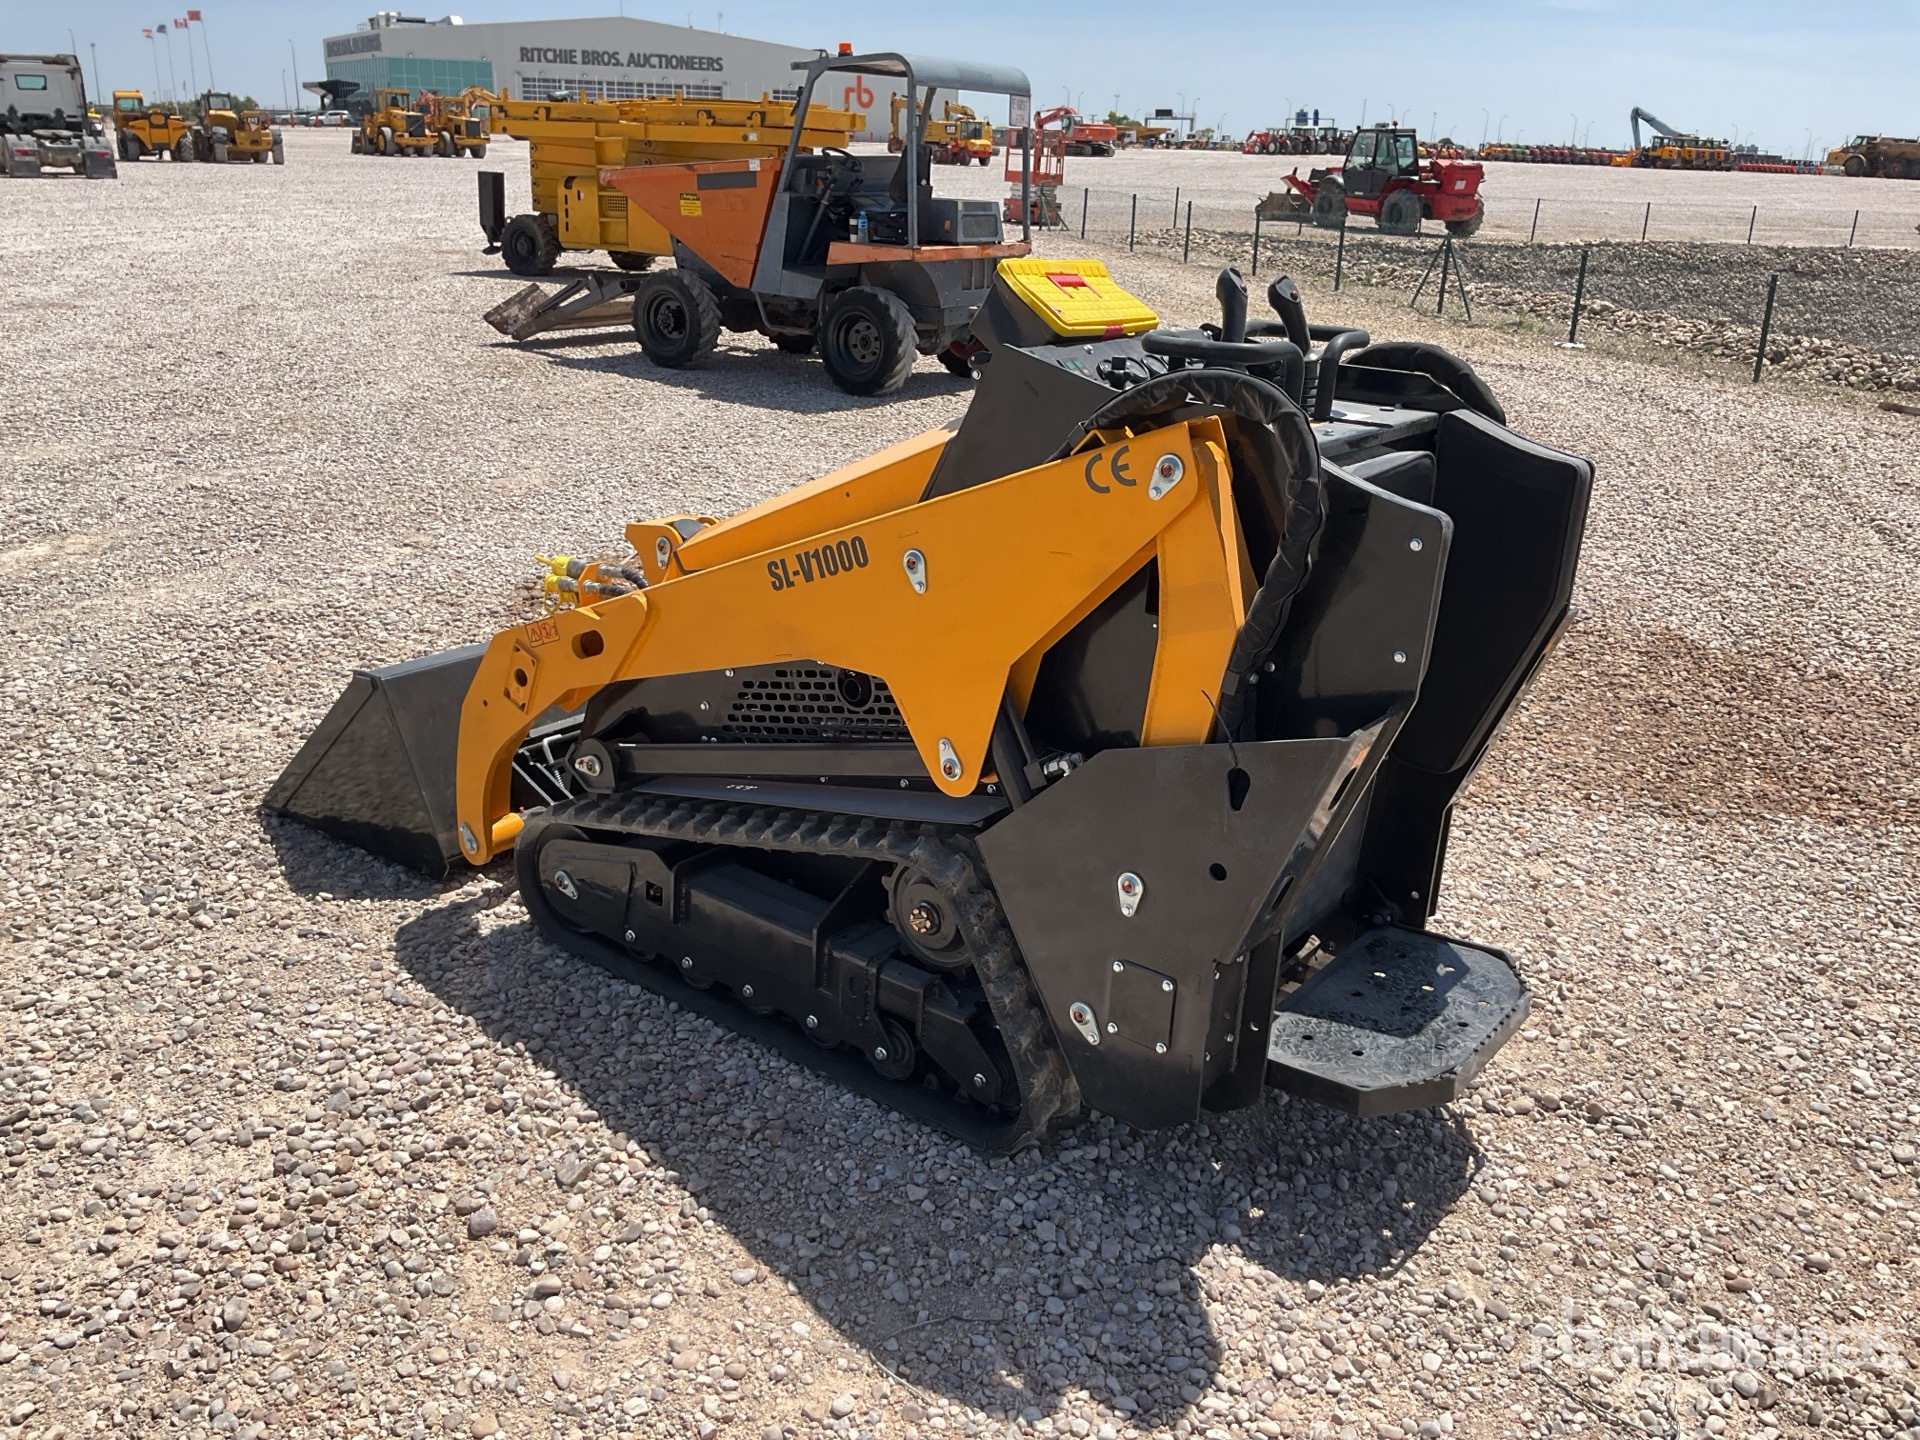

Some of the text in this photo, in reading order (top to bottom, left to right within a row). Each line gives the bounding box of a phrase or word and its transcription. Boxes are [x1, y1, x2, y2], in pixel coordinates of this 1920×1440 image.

[519, 46, 724, 72] RITCHIE BROS. AUCTIONEERS
[844, 73, 874, 113] rb
[1085, 445, 1137, 494] CE
[767, 535, 869, 592] SL-V1000
